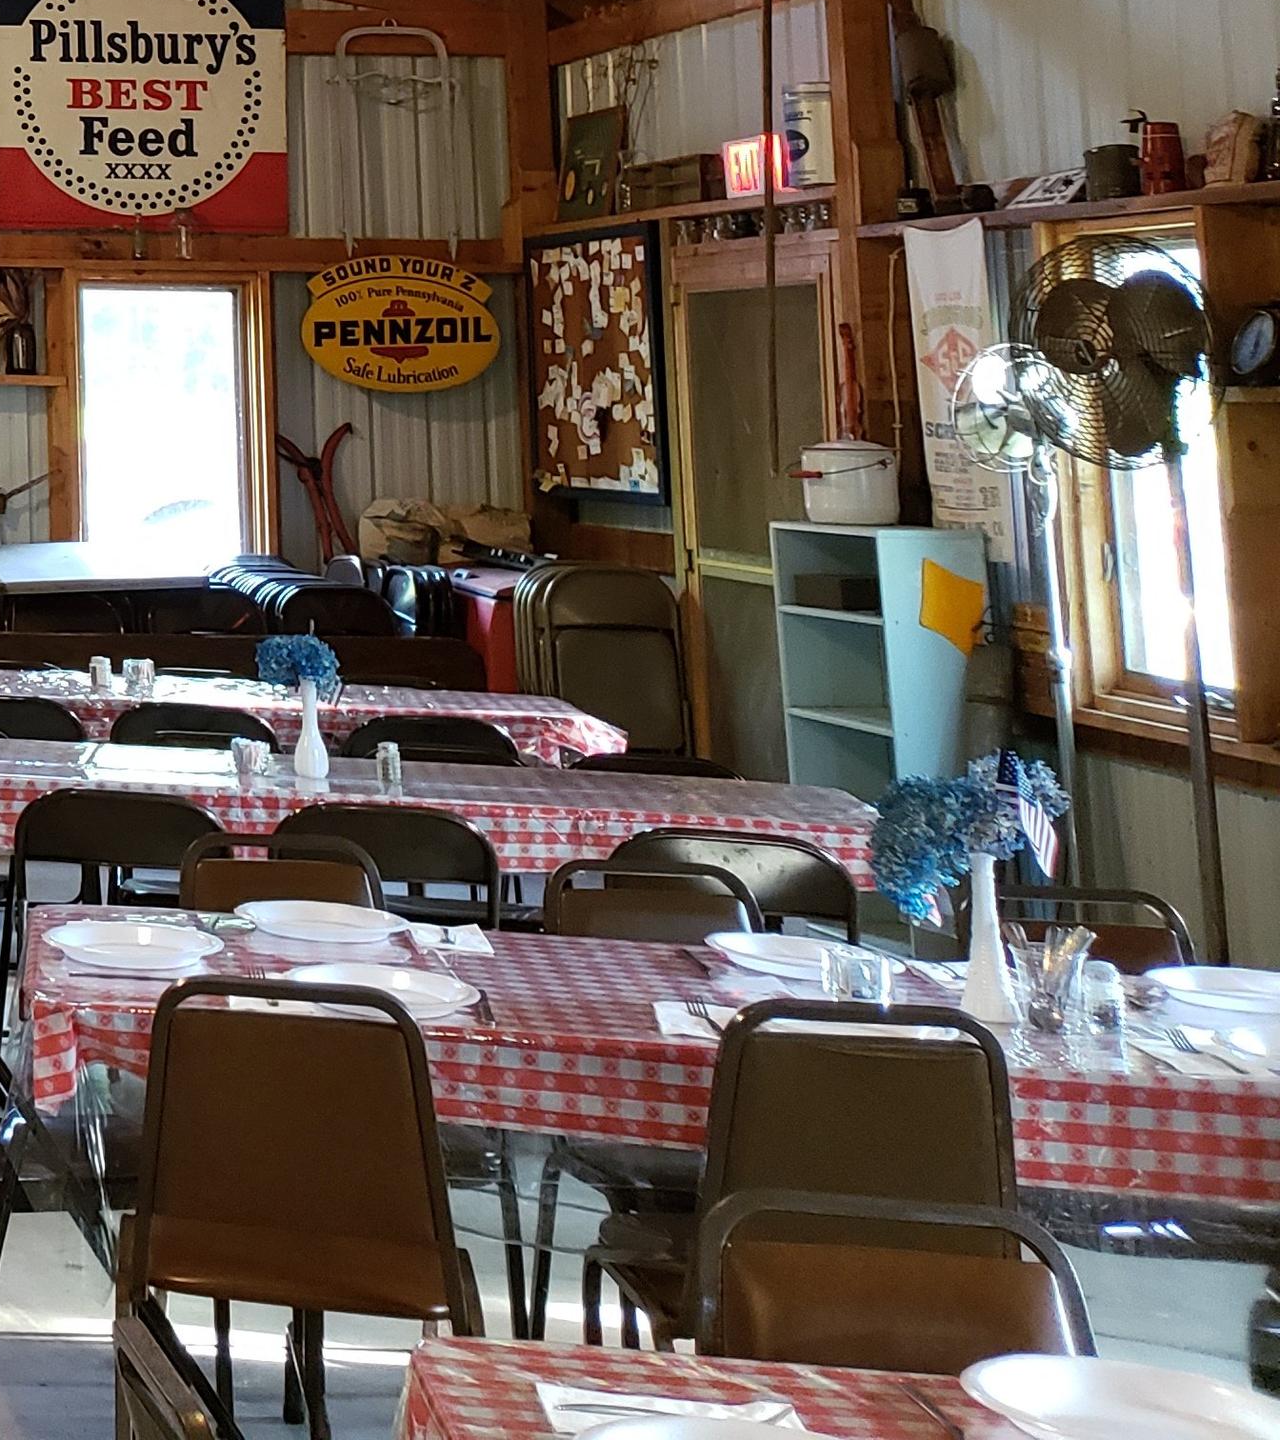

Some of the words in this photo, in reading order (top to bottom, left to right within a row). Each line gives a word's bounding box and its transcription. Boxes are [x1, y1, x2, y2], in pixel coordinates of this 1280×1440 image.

[29, 19, 257, 75] Pillsbury's
[66, 78, 208, 111] BEST
[79, 116, 199, 157] Feed
[105, 162, 172, 180] XXXX
[322, 258, 391, 287] SOUND
[399, 258, 454, 282] YOUR
[367, 287, 392, 298] Pure
[396, 286, 464, 313] Pennsylvania
[314, 316, 493, 347] PENNZOIL
[343, 357, 374, 380] Safe
[377, 364, 459, 385] Lubrication
